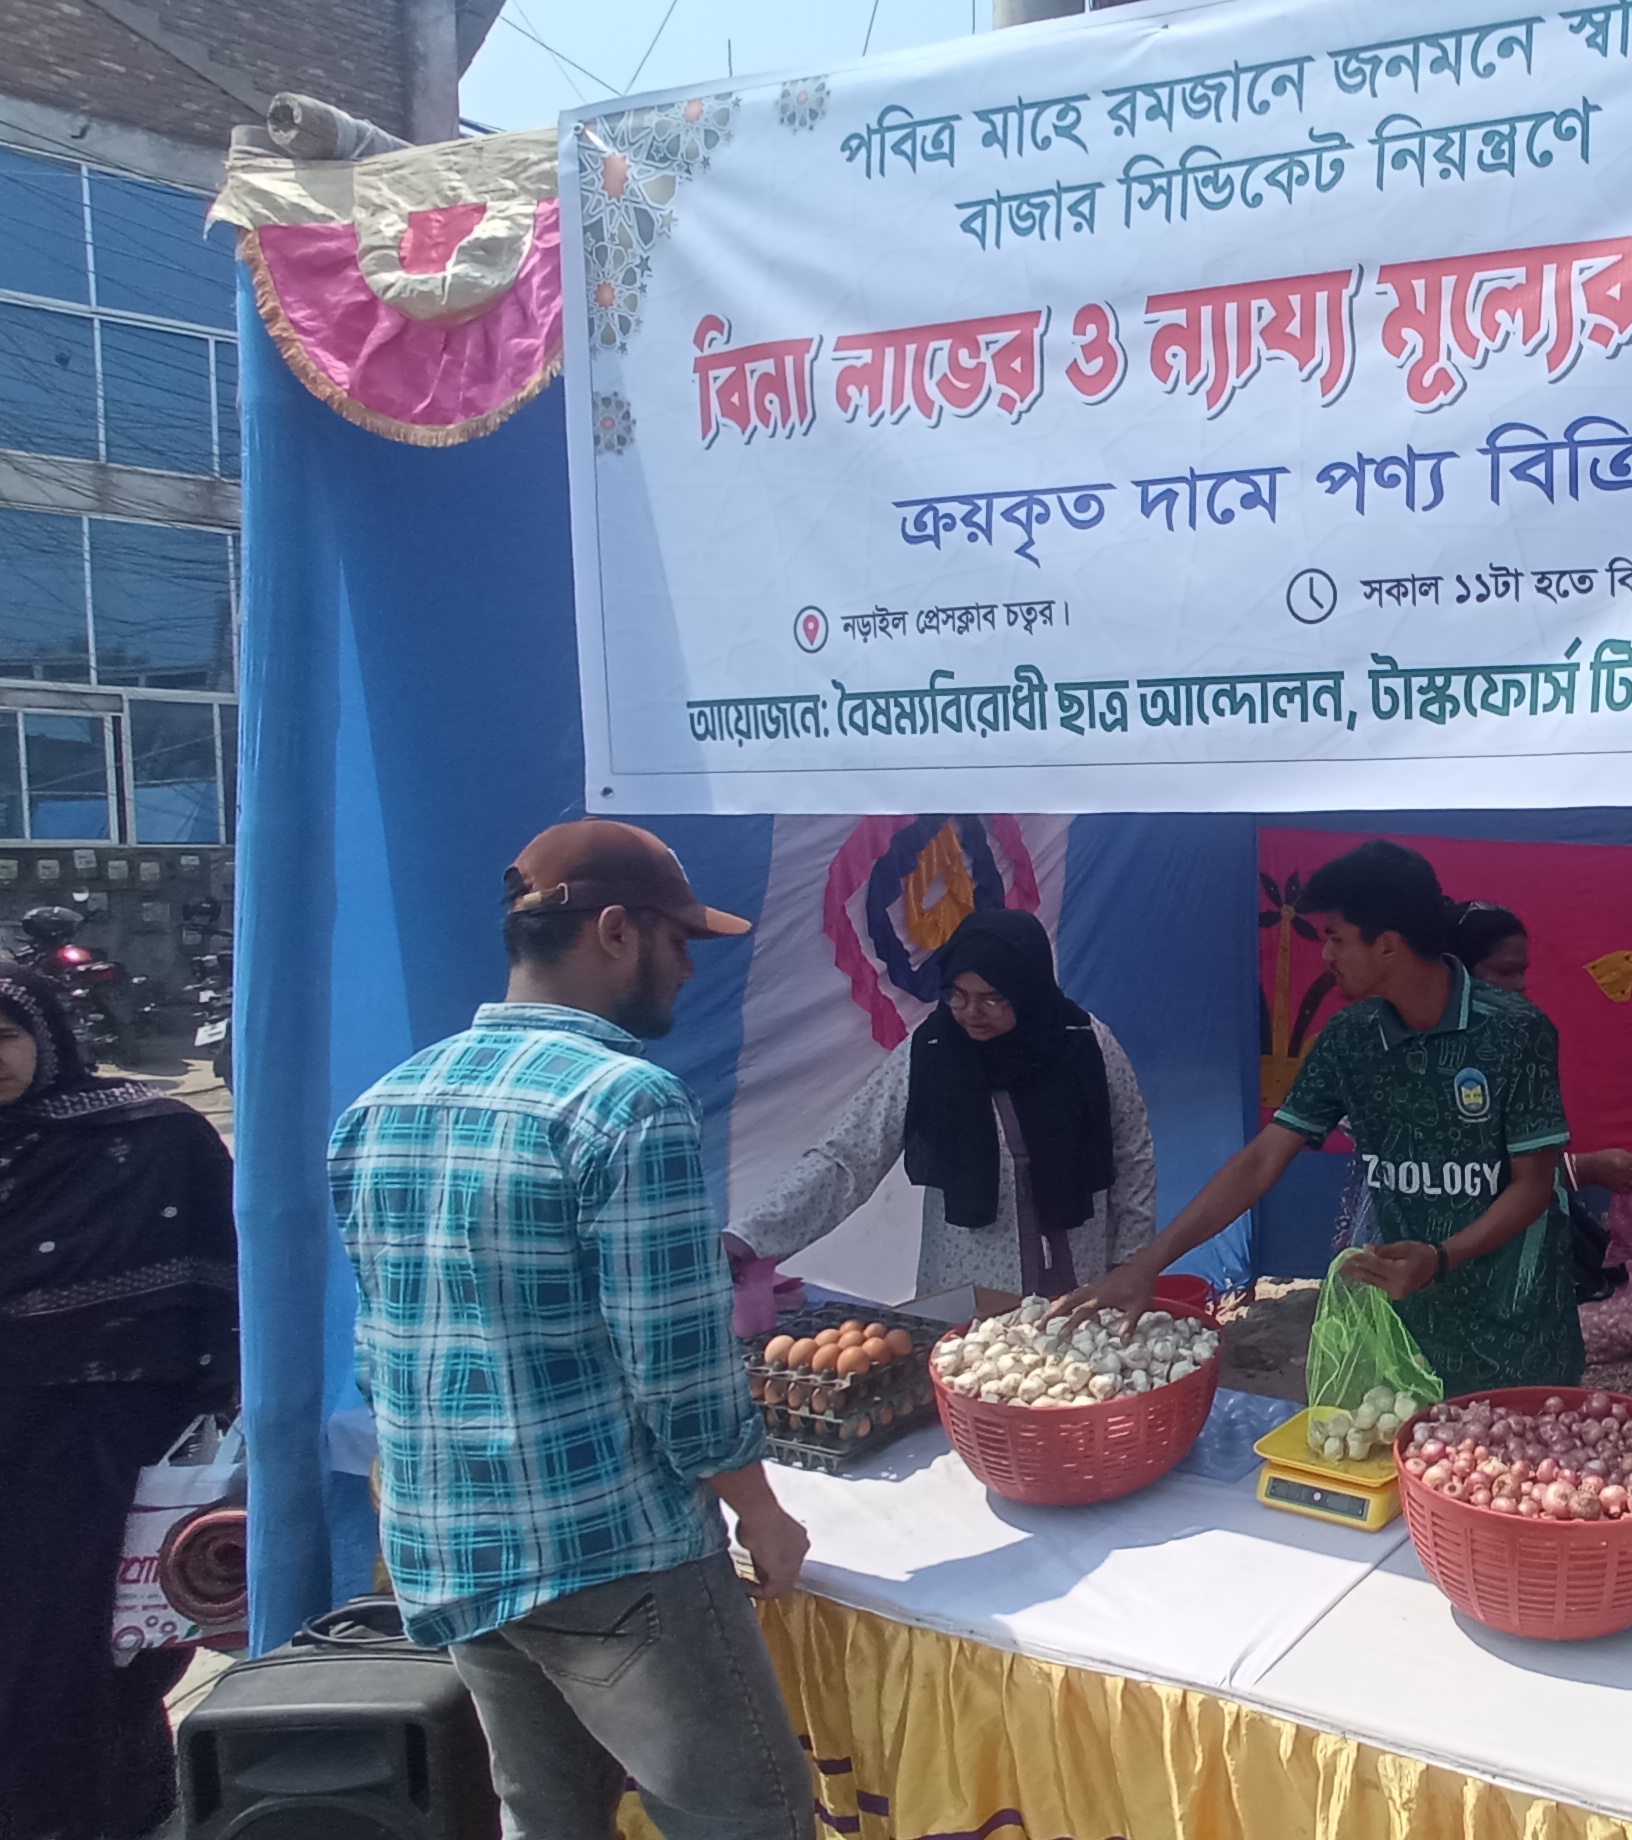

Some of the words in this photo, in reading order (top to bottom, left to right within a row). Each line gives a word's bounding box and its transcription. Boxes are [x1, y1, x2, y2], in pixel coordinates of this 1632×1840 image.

[840, 104, 963, 180] পবিত্র
[971, 92, 1092, 159] মাহে
[1101, 60, 1315, 138] রমজানে
[1325, 14, 1546, 99] জনমনে
[954, 179, 1106, 252] বাজার
[1117, 127, 1353, 230] সিন্ডিকেট
[1367, 96, 1603, 192] নিয়ন্ত্রণে
[692, 313, 823, 451] বিনা
[831, 304, 1051, 426] লাভের
[1064, 299, 1129, 407] ও
[1143, 262, 1365, 422] ন্যায্য
[891, 482, 1117, 569] ক্রয়কৃত
[1130, 466, 1292, 533] দামে
[1315, 443, 1461, 517] পণ্য
[840, 604, 910, 644] নড়াইল
[915, 602, 999, 636] প্রেসক্লাব
[1359, 573, 1445, 609] সকাল
[1455, 562, 1525, 604] ১১টা
[1530, 568, 1599, 604] হতে
[685, 694, 830, 748] আয়োজনে:
[830, 664, 1049, 739] বৈষম্যবিরোধী
[1054, 679, 1130, 737] ছাত্র
[1136, 670, 1358, 732] আন্দোলন,
[1367, 636, 1583, 725] টাস্কফোর্স
[1361, 1153, 1502, 1196] ZOOLOGY
